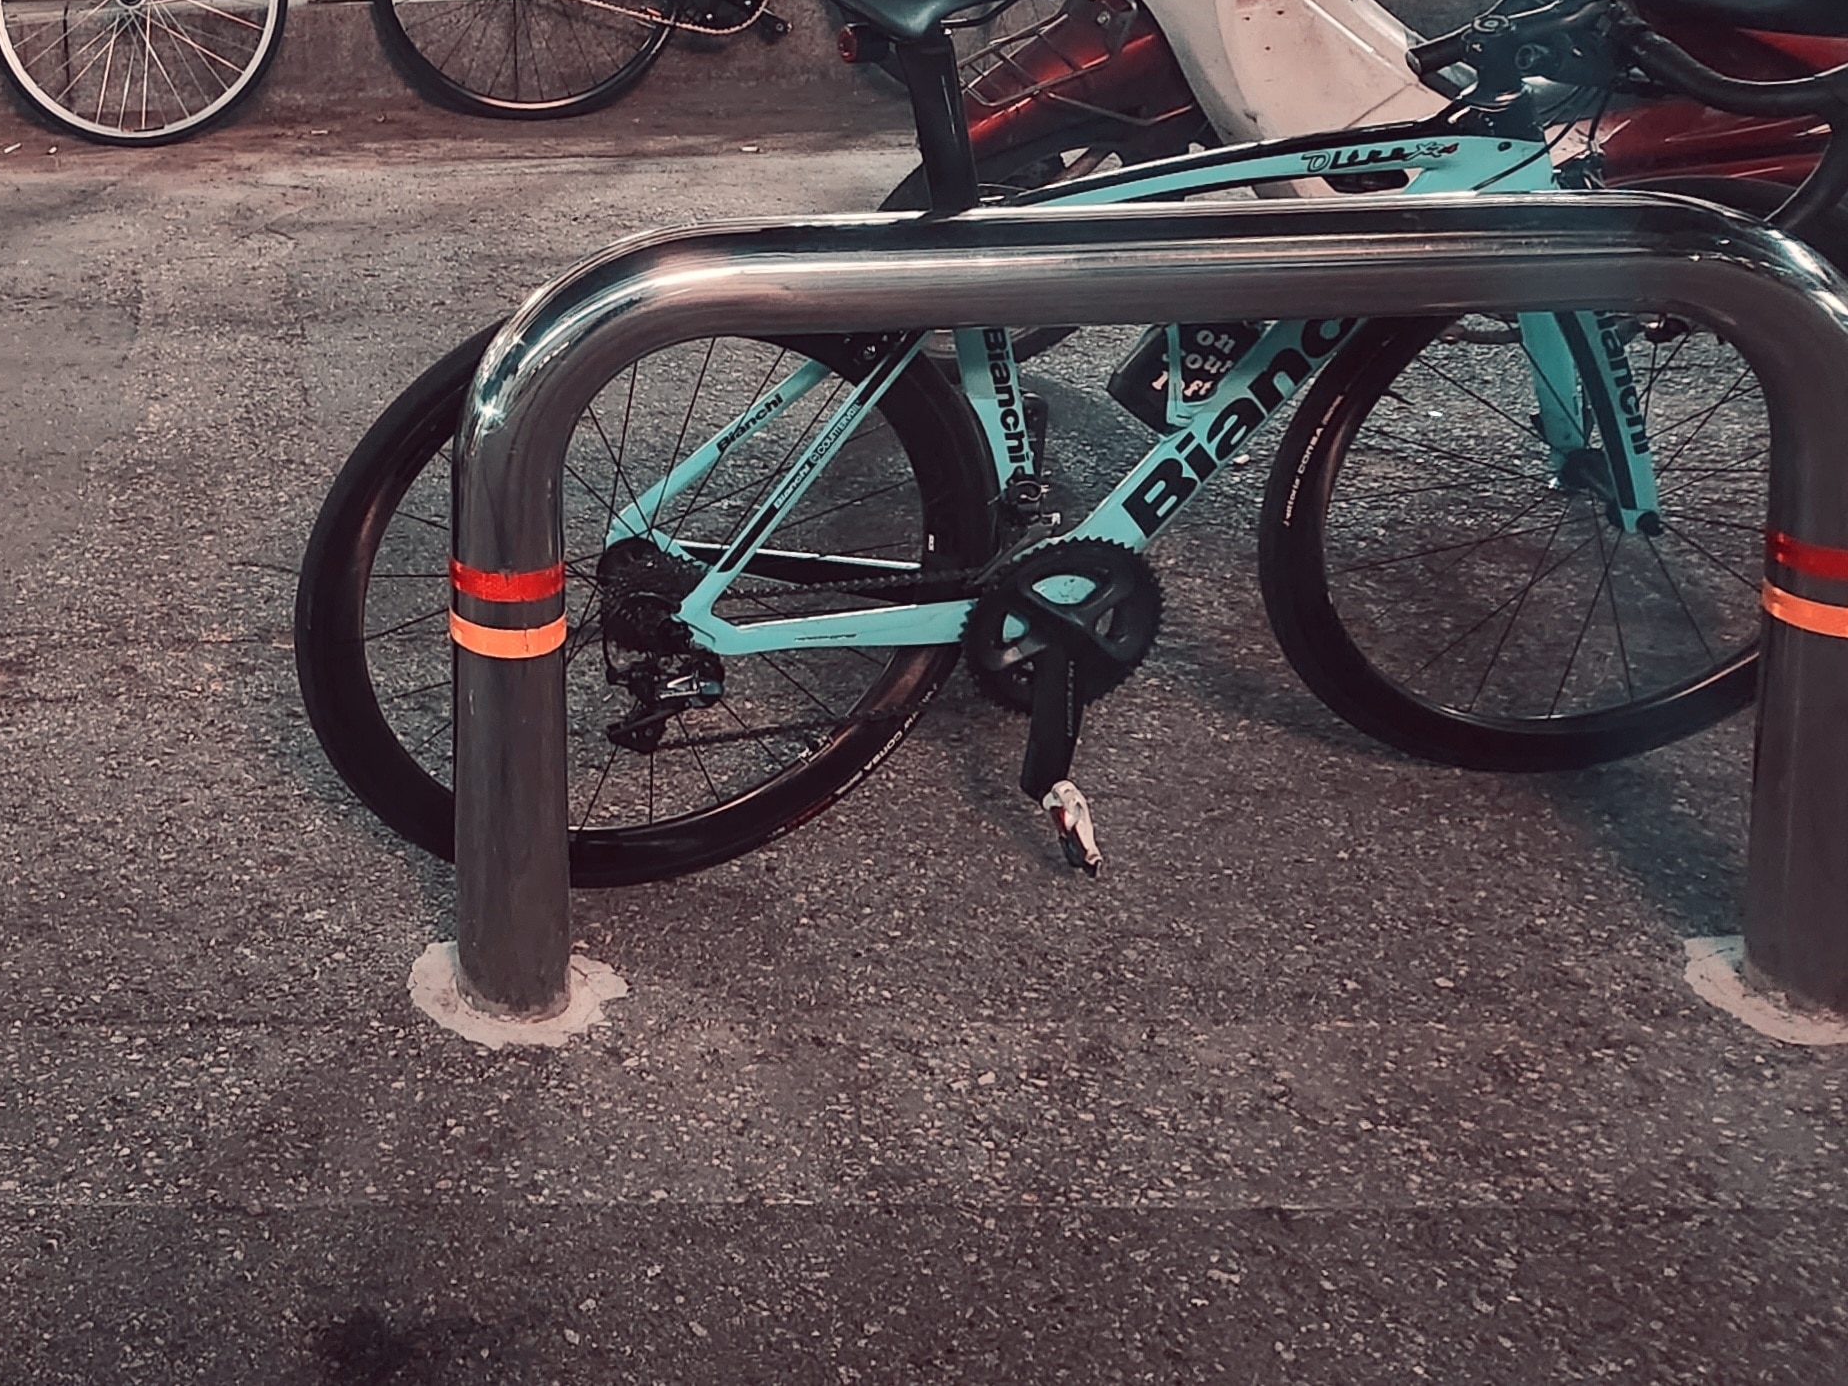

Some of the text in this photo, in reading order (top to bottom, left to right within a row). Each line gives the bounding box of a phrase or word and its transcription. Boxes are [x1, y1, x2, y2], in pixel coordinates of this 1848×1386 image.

[1196, 328, 1237, 355] on
[1594, 311, 1650, 456] ianchi
[716, 392, 785, 454] Bianchi
[982, 327, 1030, 465] Bianchi
